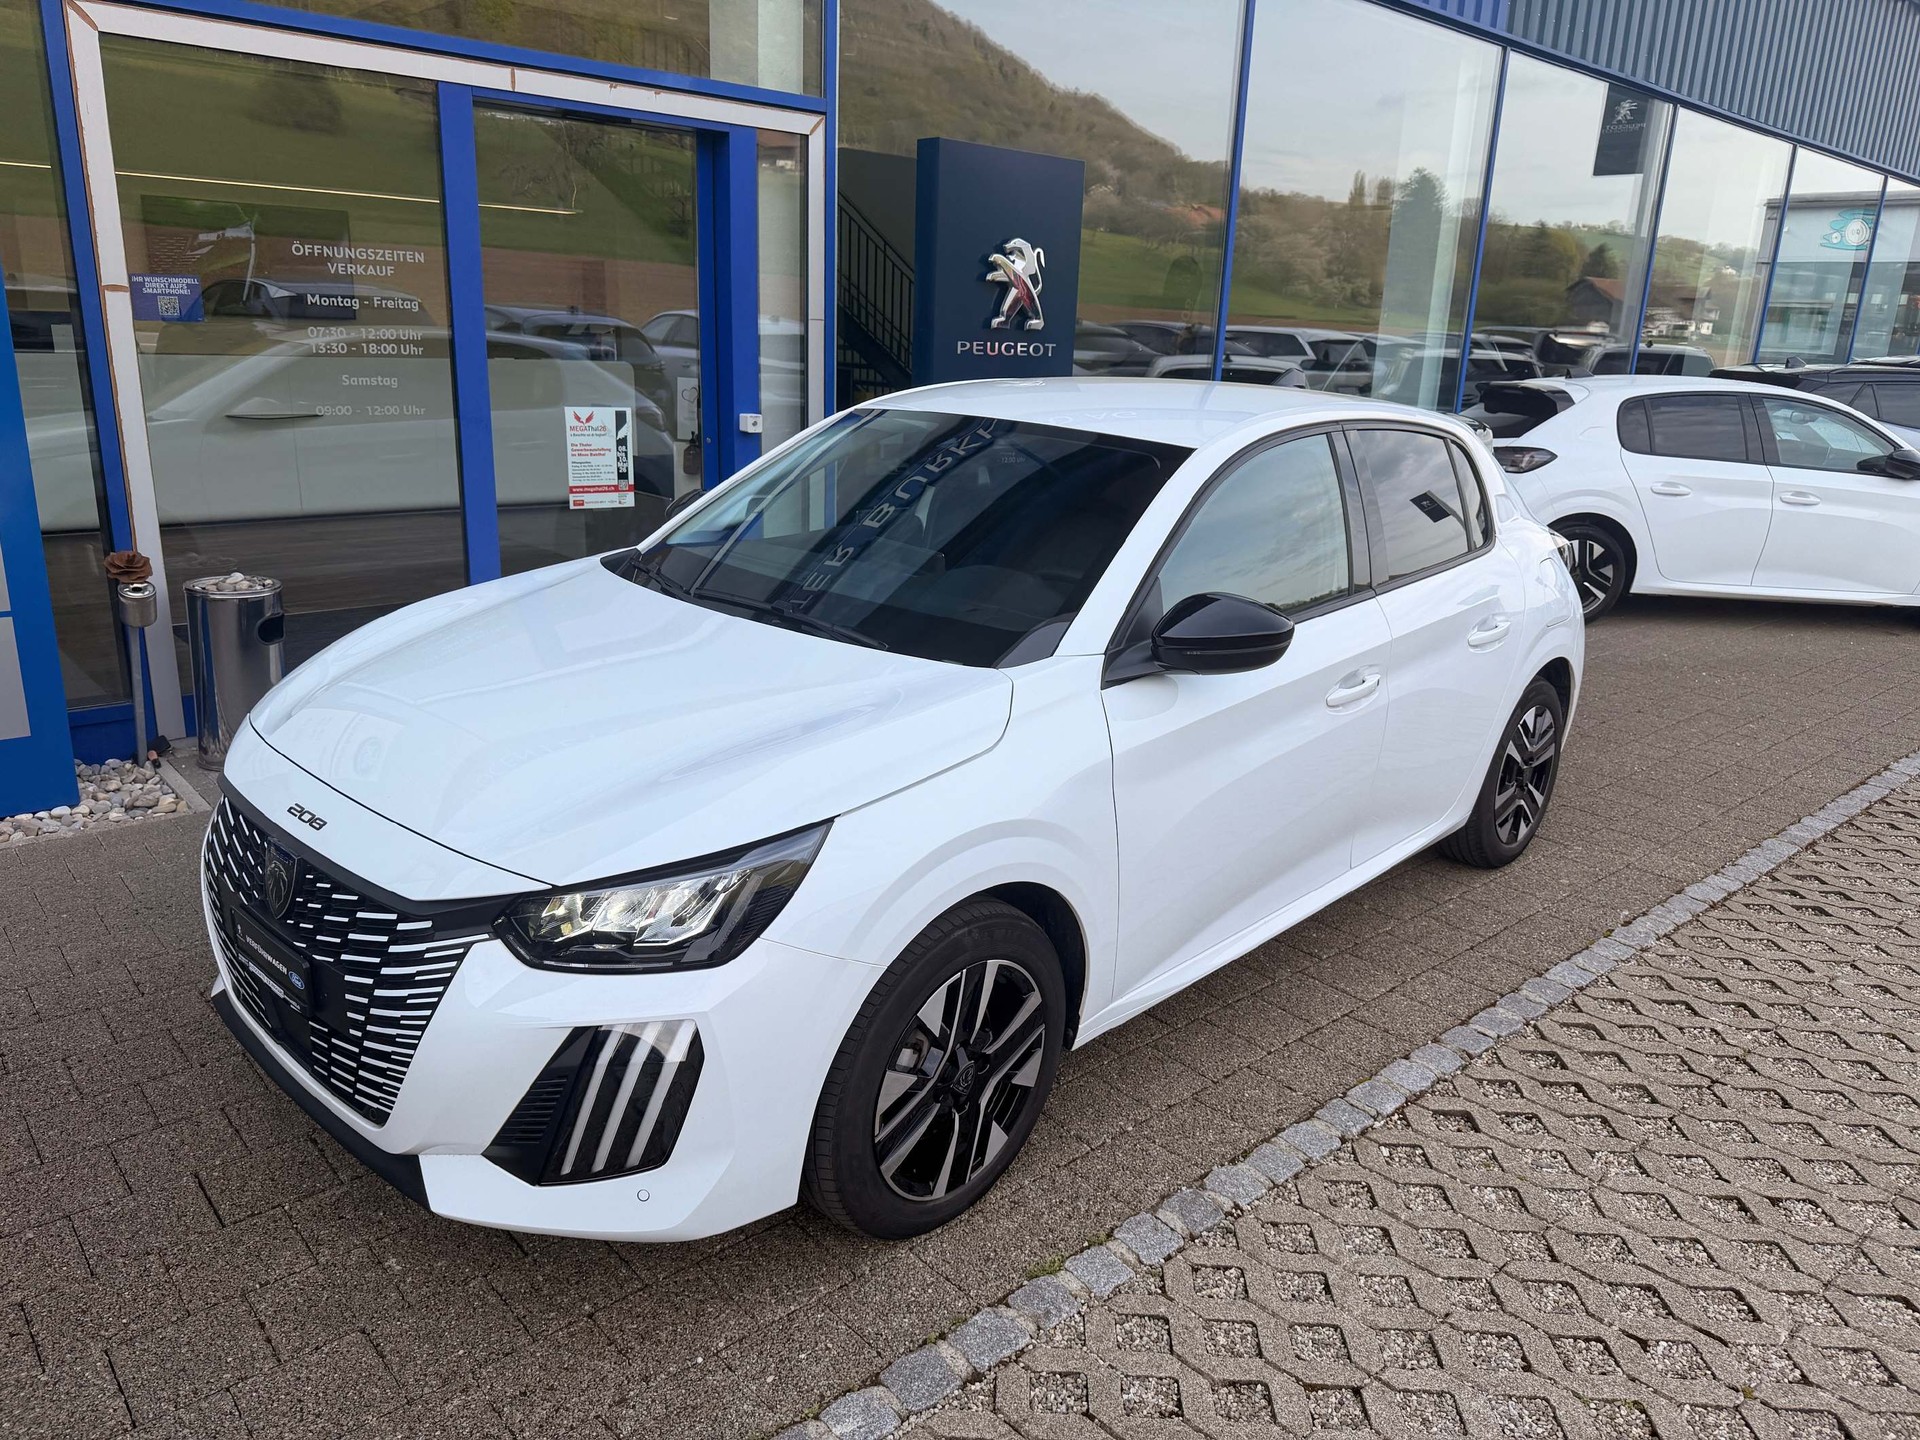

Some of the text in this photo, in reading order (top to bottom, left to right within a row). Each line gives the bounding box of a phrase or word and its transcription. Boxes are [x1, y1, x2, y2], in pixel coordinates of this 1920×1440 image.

[291, 240, 425, 263] ÖFFNUNGSZEITEN
[327, 262, 395, 276] VERKAUF
[144, 276, 199, 285] WUNSCHMODELL
[306, 293, 360, 309] Montag
[373, 297, 419, 312] Freitag
[307, 326, 346, 338] 07:30
[360, 328, 397, 340] 12:00
[400, 329, 422, 340] Uhr
[311, 343, 348, 354] 13:30
[361, 343, 398, 355] 18:00
[400, 344, 424, 355] Uhr
[957, 341, 1056, 357] PEUGEOT
[342, 375, 398, 388] Samstag
[316, 405, 353, 416] 09:00
[366, 405, 400, 416] 12:00
[402, 405, 426, 416] Uhr
[287, 803, 328, 831] 208
